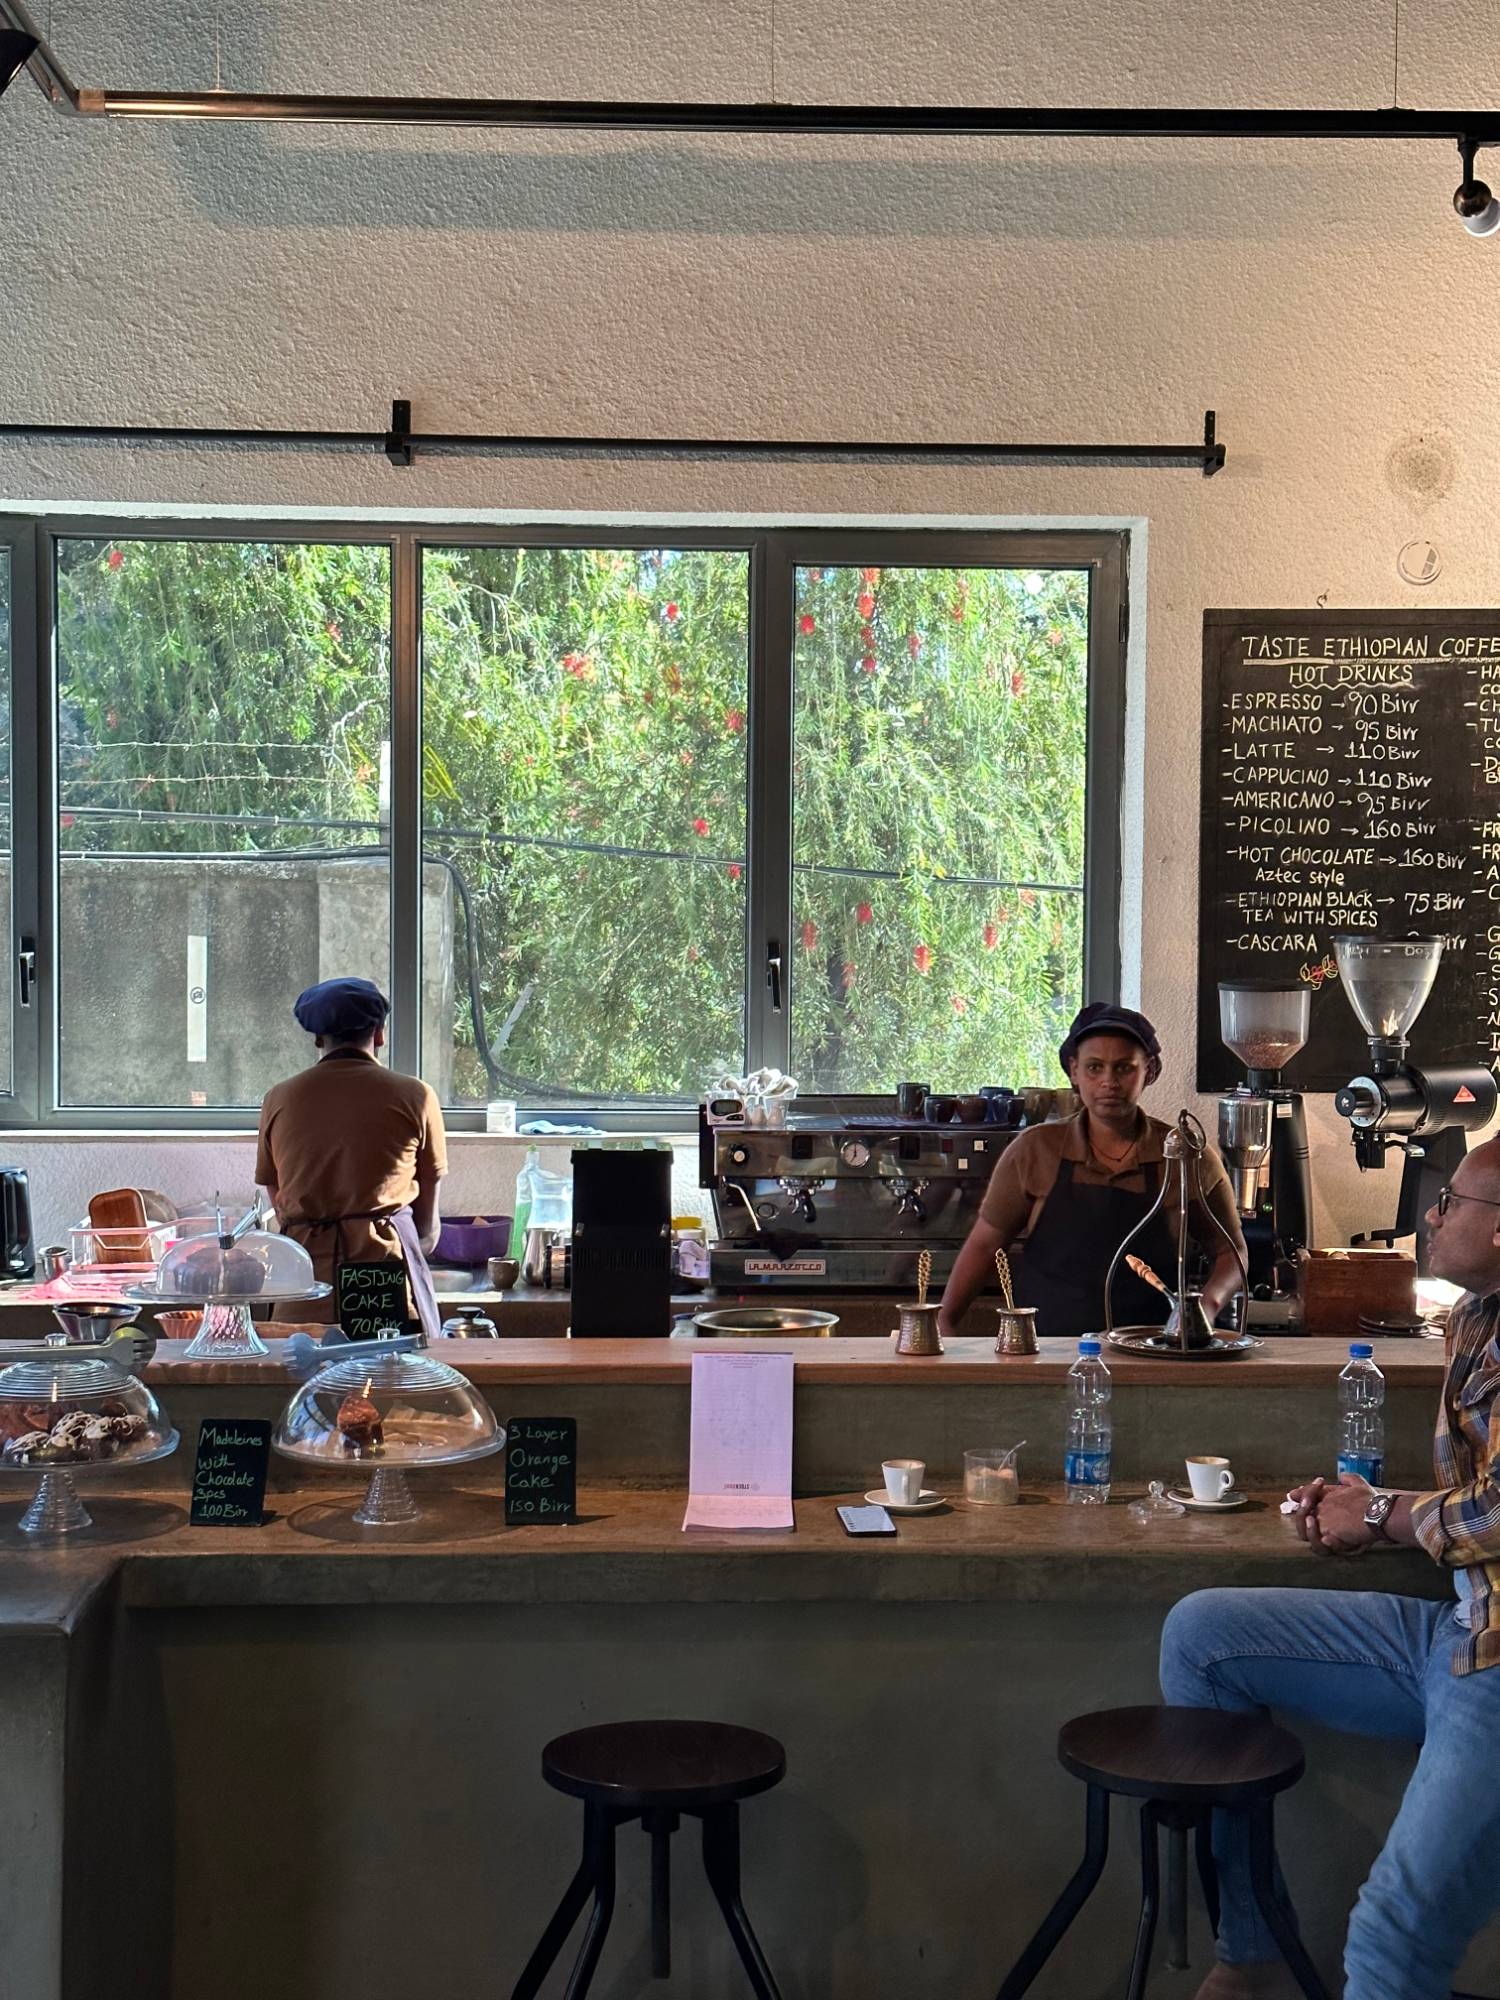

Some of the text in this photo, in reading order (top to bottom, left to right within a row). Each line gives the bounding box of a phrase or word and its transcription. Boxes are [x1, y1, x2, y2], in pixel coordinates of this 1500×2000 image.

[1242, 635, 1310, 658] TASTE
[1323, 635, 1428, 658] ETHIOPIAN
[1289, 665, 1413, 684] HOT DRINKS
[1231, 691, 1420, 716] ESPRESSO 90 Birr
[1231, 716, 1419, 742] MACHIATO 95 Birr
[1233, 742, 1421, 760] LATTE 110 Birr
[1233, 766, 1432, 790] CAPPUCINO 110 Birr
[1233, 791, 1335, 810] AMERICANO
[1391, 795, 1431, 811] Birr
[1238, 815, 1437, 840] PICOLINO 160 Birr
[1238, 846, 1467, 870] HOT CHOCOLATE 160 Birr
[1255, 867, 1345, 888] Aztec style
[1238, 889, 1466, 915] ETHIOPIAN BLACK 75 Birr
[1242, 909, 1378, 928] TEA WITH SPICES
[1237, 933, 1318, 952] CASCARA
[341, 1268, 404, 1289] FASTING
[342, 1293, 395, 1311] CAKE
[510, 1448, 571, 1475] Orange
[509, 1472, 555, 1488] Cake
